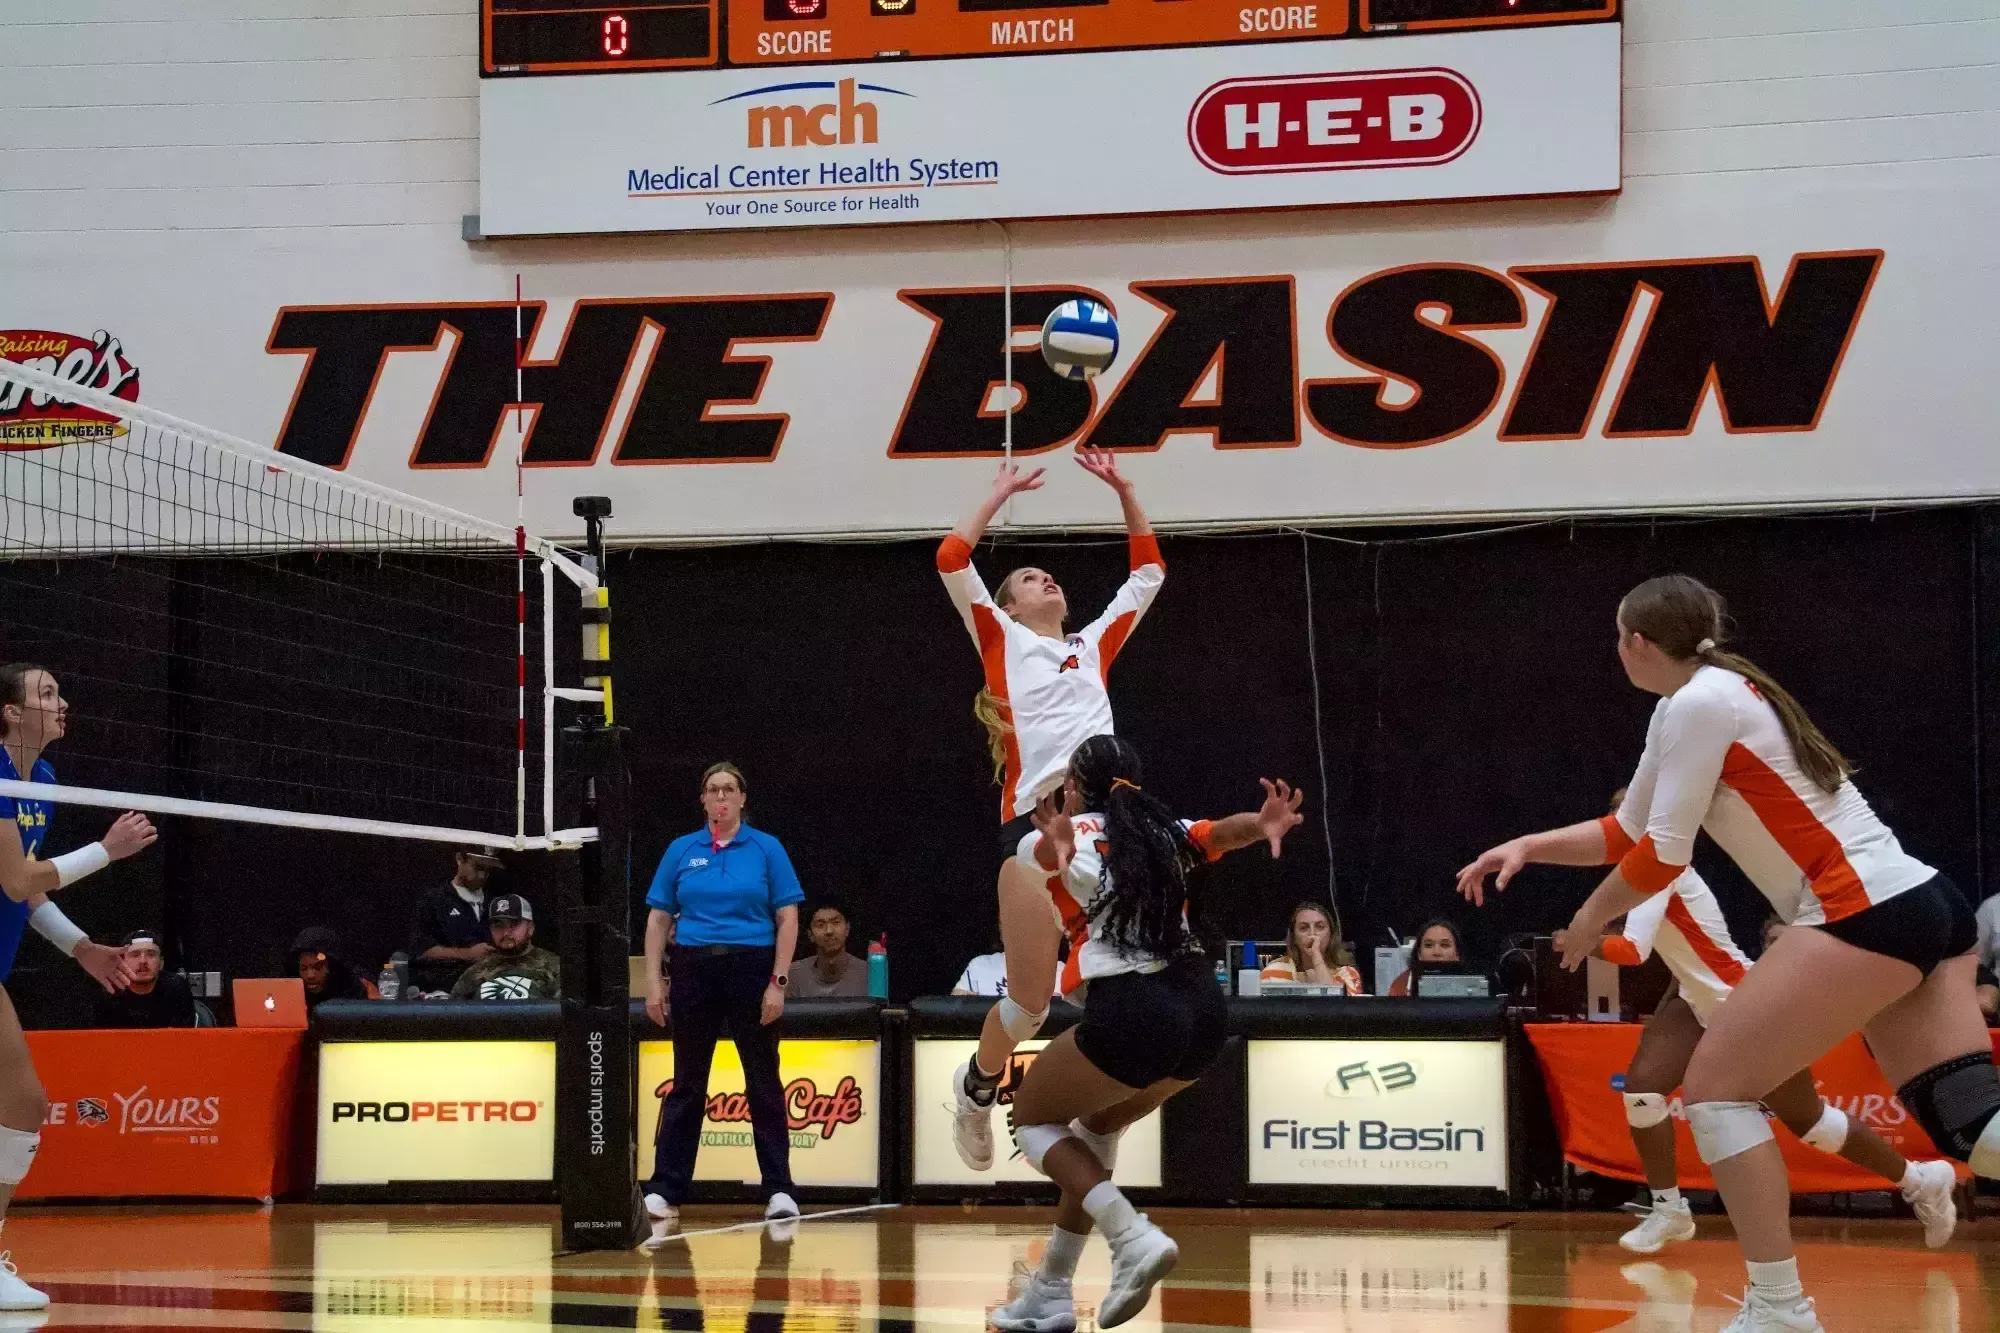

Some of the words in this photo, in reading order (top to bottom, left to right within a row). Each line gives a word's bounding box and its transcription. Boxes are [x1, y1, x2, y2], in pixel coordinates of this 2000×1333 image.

[604, 16, 627, 55] 0
[991, 18, 1074, 45] MATCH
[1239, 5, 1317, 33] SCORE
[757, 29, 832, 56] SCORE
[747, 78, 878, 148] mch
[1224, 93, 1447, 150] H-E-B
[627, 164, 719, 191] Medical
[729, 165, 811, 188] Center
[819, 157, 900, 185] Health
[909, 158, 999, 187] System
[706, 202, 742, 216] Your
[746, 200, 779, 214] One
[784, 198, 837, 213] Source
[842, 196, 864, 211] for
[869, 194, 920, 210] Health
[265, 292, 836, 470] THE
[887, 249, 1884, 459] BASIN
[587, 1031, 605, 1086] sports
[113, 1085, 220, 1135] YOURS
[587, 1089, 606, 1155] imports
[783, 1076, 863, 1139] Café
[1263, 1119, 1350, 1150] First
[1358, 1120, 1484, 1152] Basin
[1298, 1157, 1368, 1169] credit
[1379, 1158, 1449, 1169] union
